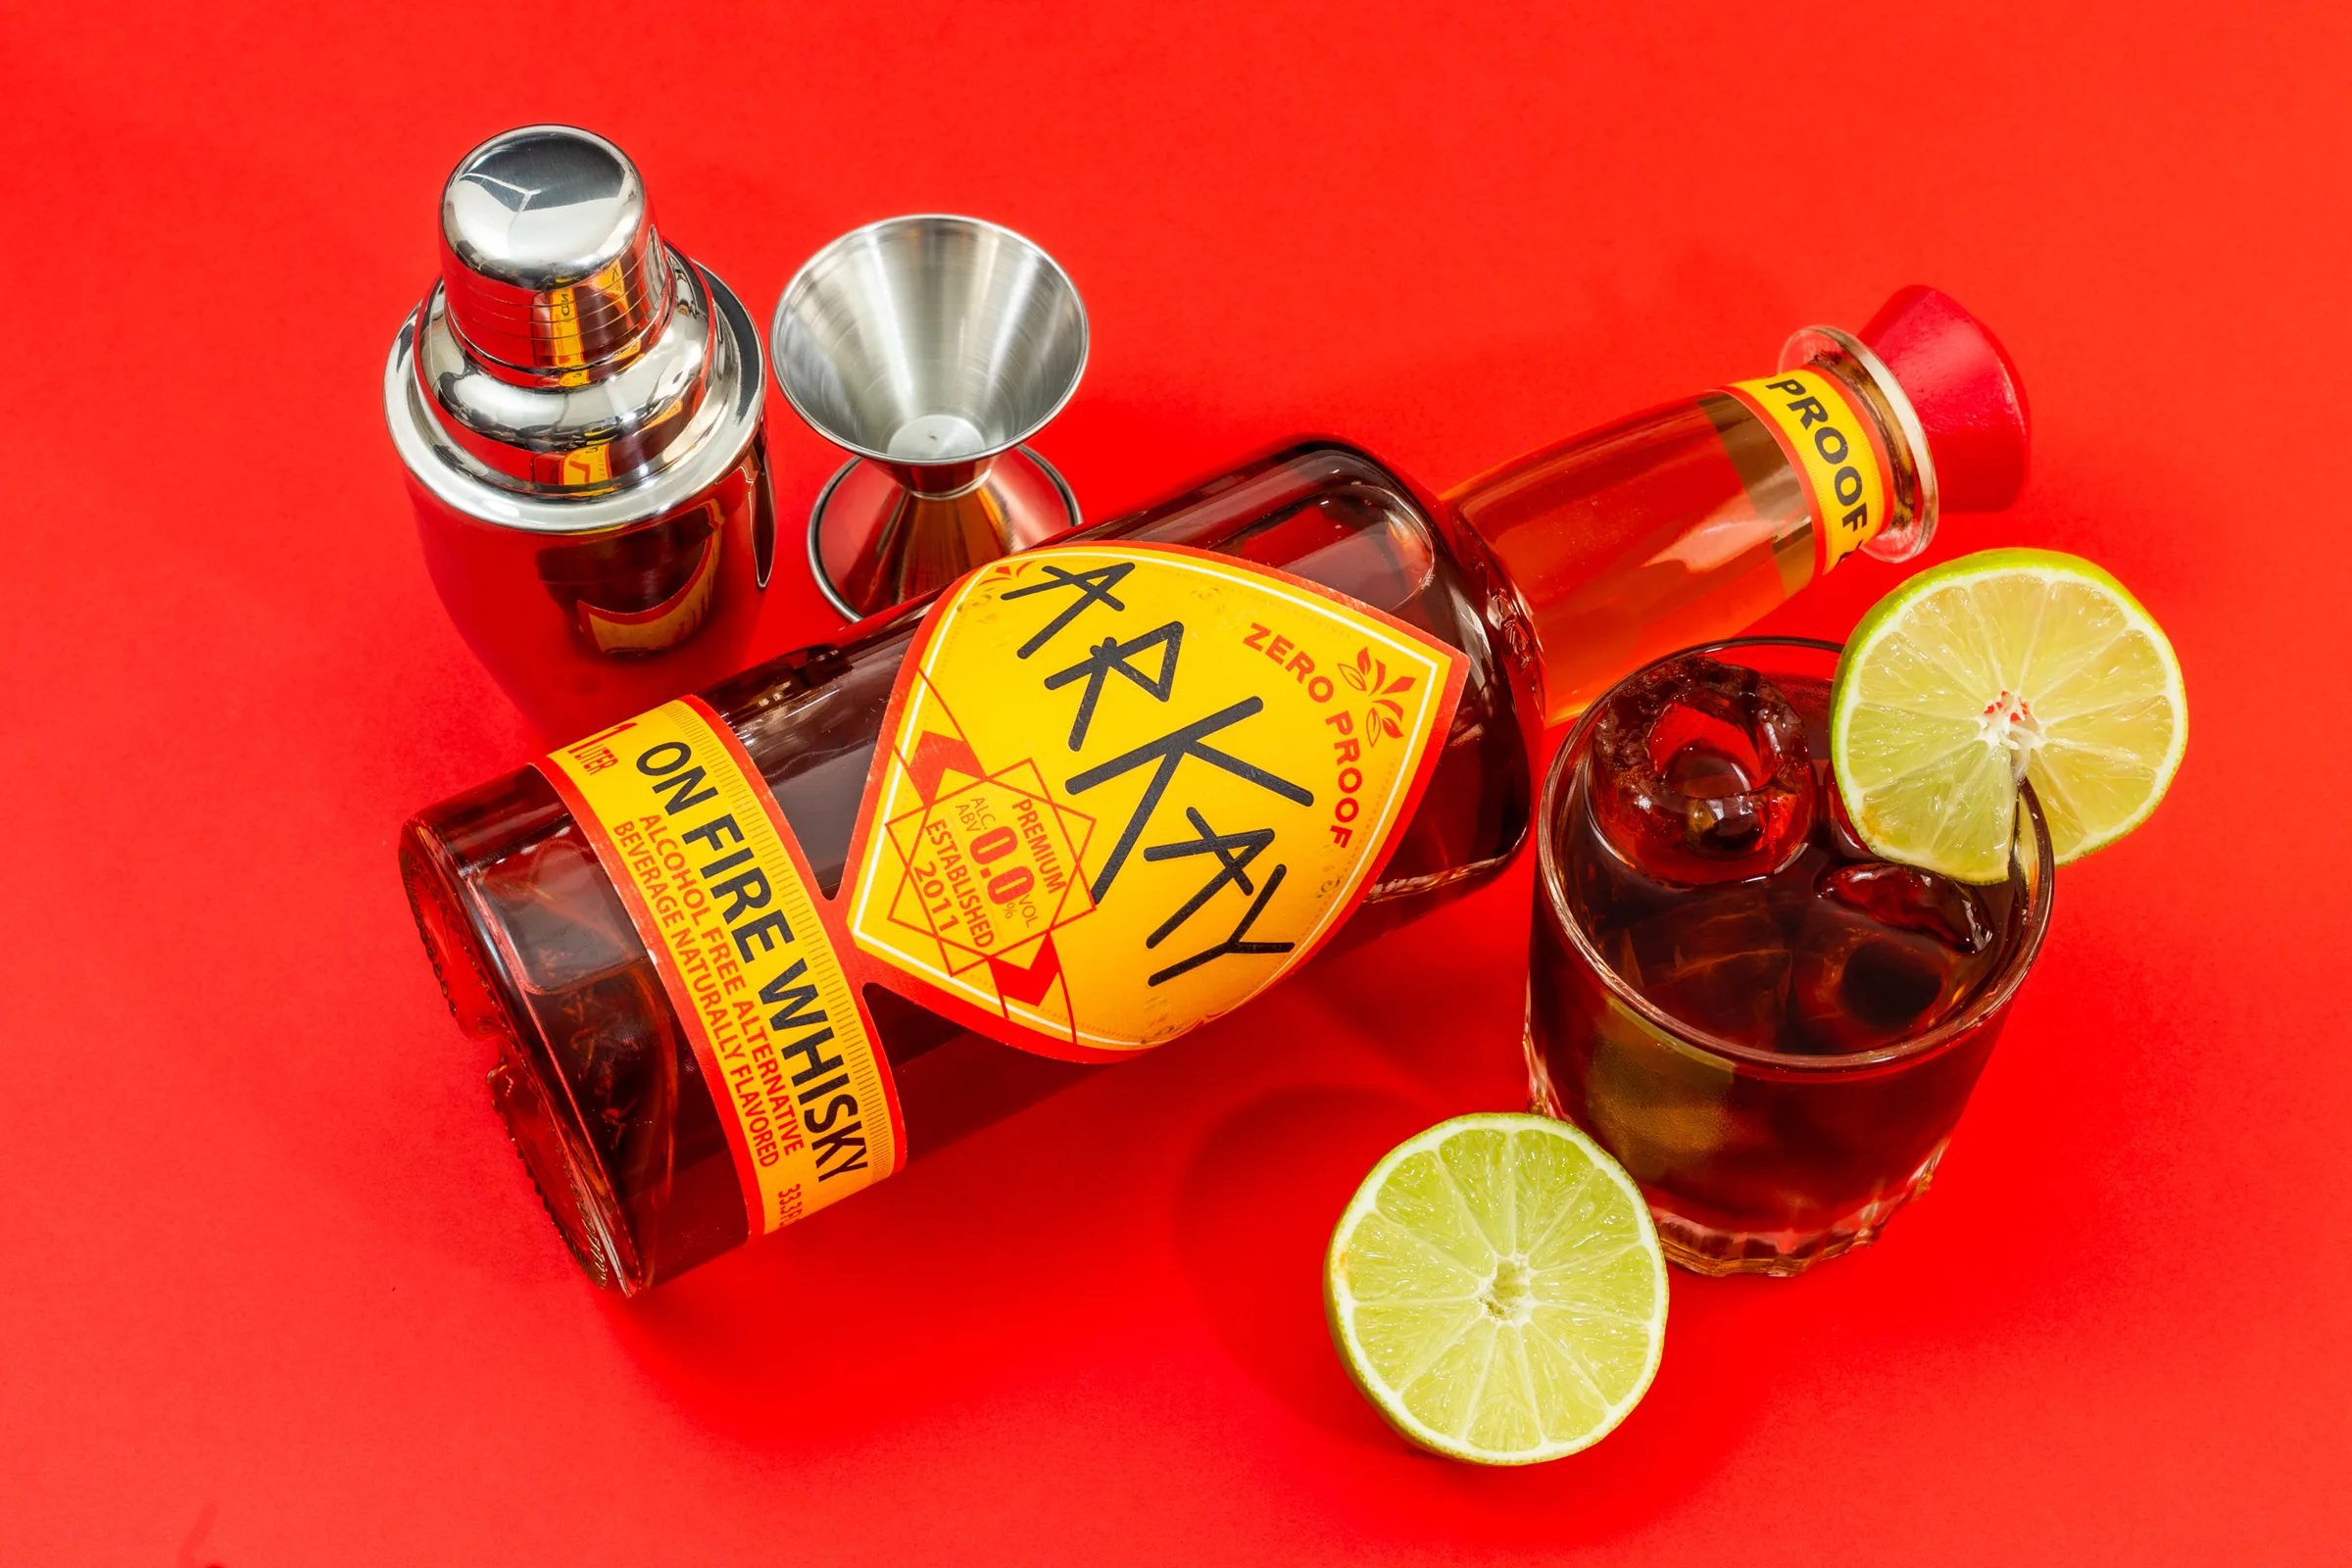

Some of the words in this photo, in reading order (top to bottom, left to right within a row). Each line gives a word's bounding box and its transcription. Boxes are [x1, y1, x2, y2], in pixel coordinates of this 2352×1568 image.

[1766, 378, 1868, 532] PROOF
[573, 743, 619, 776] LITER
[1000, 562, 1315, 987] ARKAY
[1243, 621, 1335, 703] ZERO
[1325, 710, 1363, 849] PROOF
[925, 818, 995, 948] ESTABLISHED
[955, 804, 980, 832] ABV
[969, 825, 1035, 906] 0.0
[1018, 895, 1039, 928] VOL
[1011, 798, 1067, 894] PREMIUM
[636, 741, 719, 816] ON
[681, 813, 795, 963] FIRE
[758, 957, 868, 1183] WHISKY
[913, 860, 959, 932] 2011
[613, 820, 685, 928] BEVERAGE
[670, 927, 746, 1060] NATURALLY
[730, 1064, 779, 1167] FLAVORED
[638, 814, 711, 927] ALCOHOL
[701, 926, 746, 996] FREE
[732, 1001, 805, 1156] ALTERNATIVE
